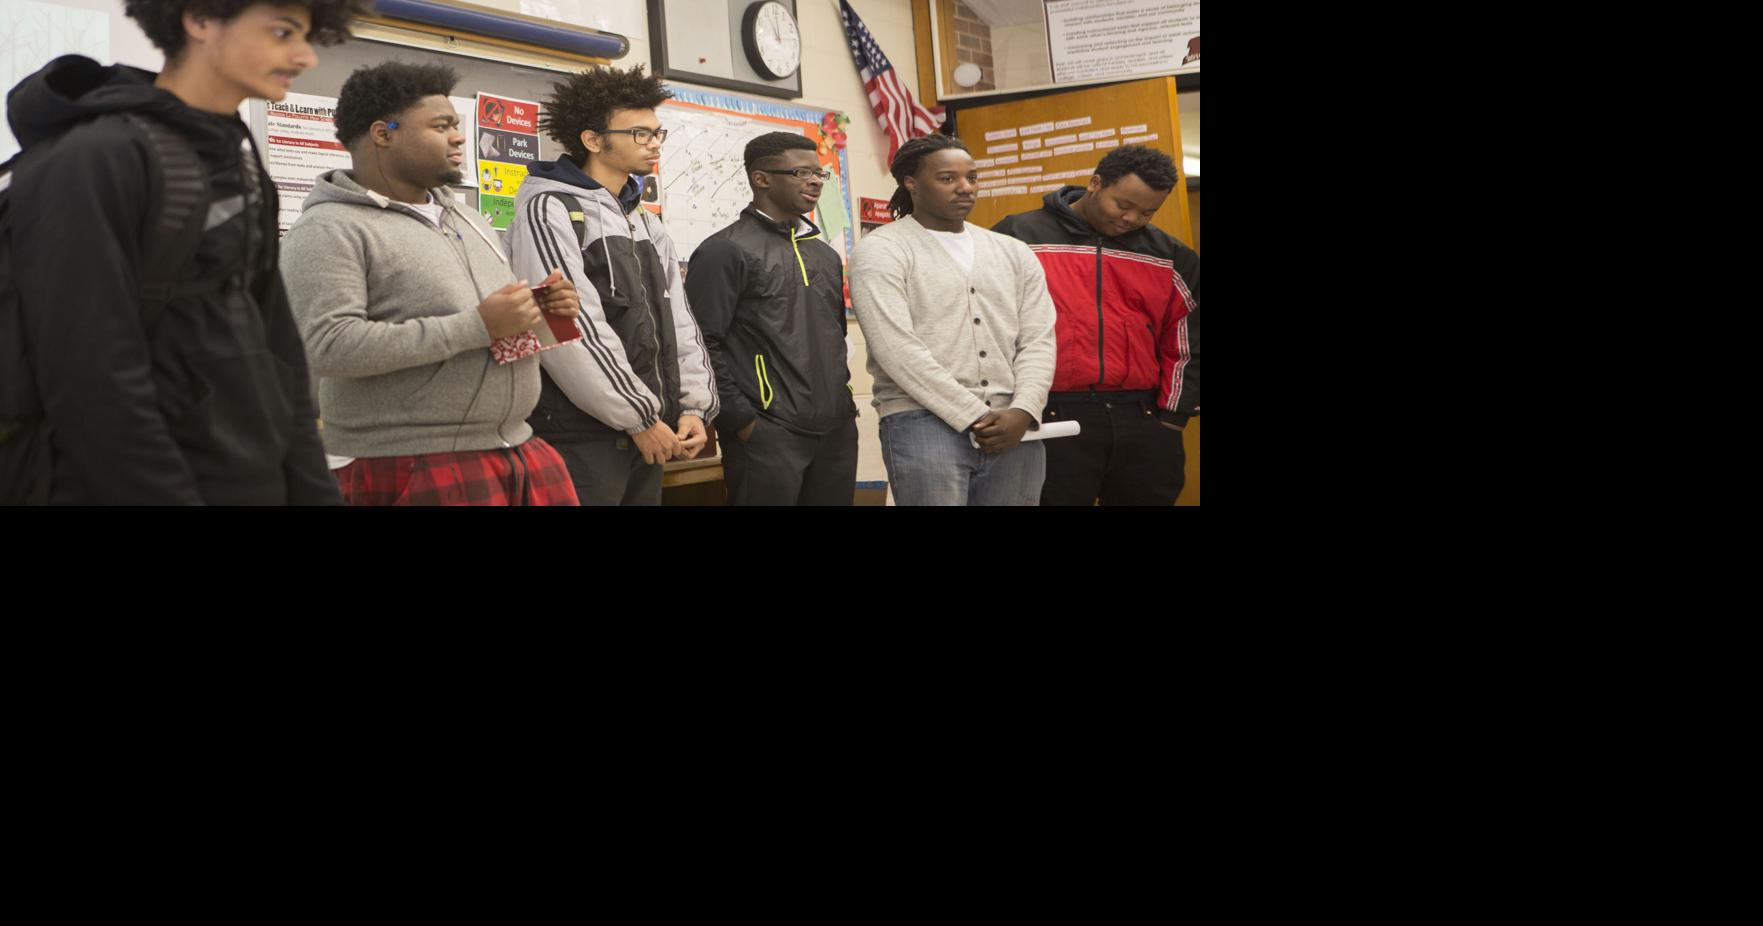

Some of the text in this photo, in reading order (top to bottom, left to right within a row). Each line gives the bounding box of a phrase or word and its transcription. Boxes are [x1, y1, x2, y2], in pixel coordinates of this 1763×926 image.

[271, 101, 289, 111] Teach
[290, 104, 295, 113] &
[296, 104, 313, 114] Learn
[314, 106, 326, 116] with
[514, 106, 524, 116] No
[507, 116, 531, 127] Devices
[513, 137, 528, 148] Park
[509, 148, 534, 160] Devices
[505, 168, 528, 177] Instruc
[494, 198, 514, 208] Indep
